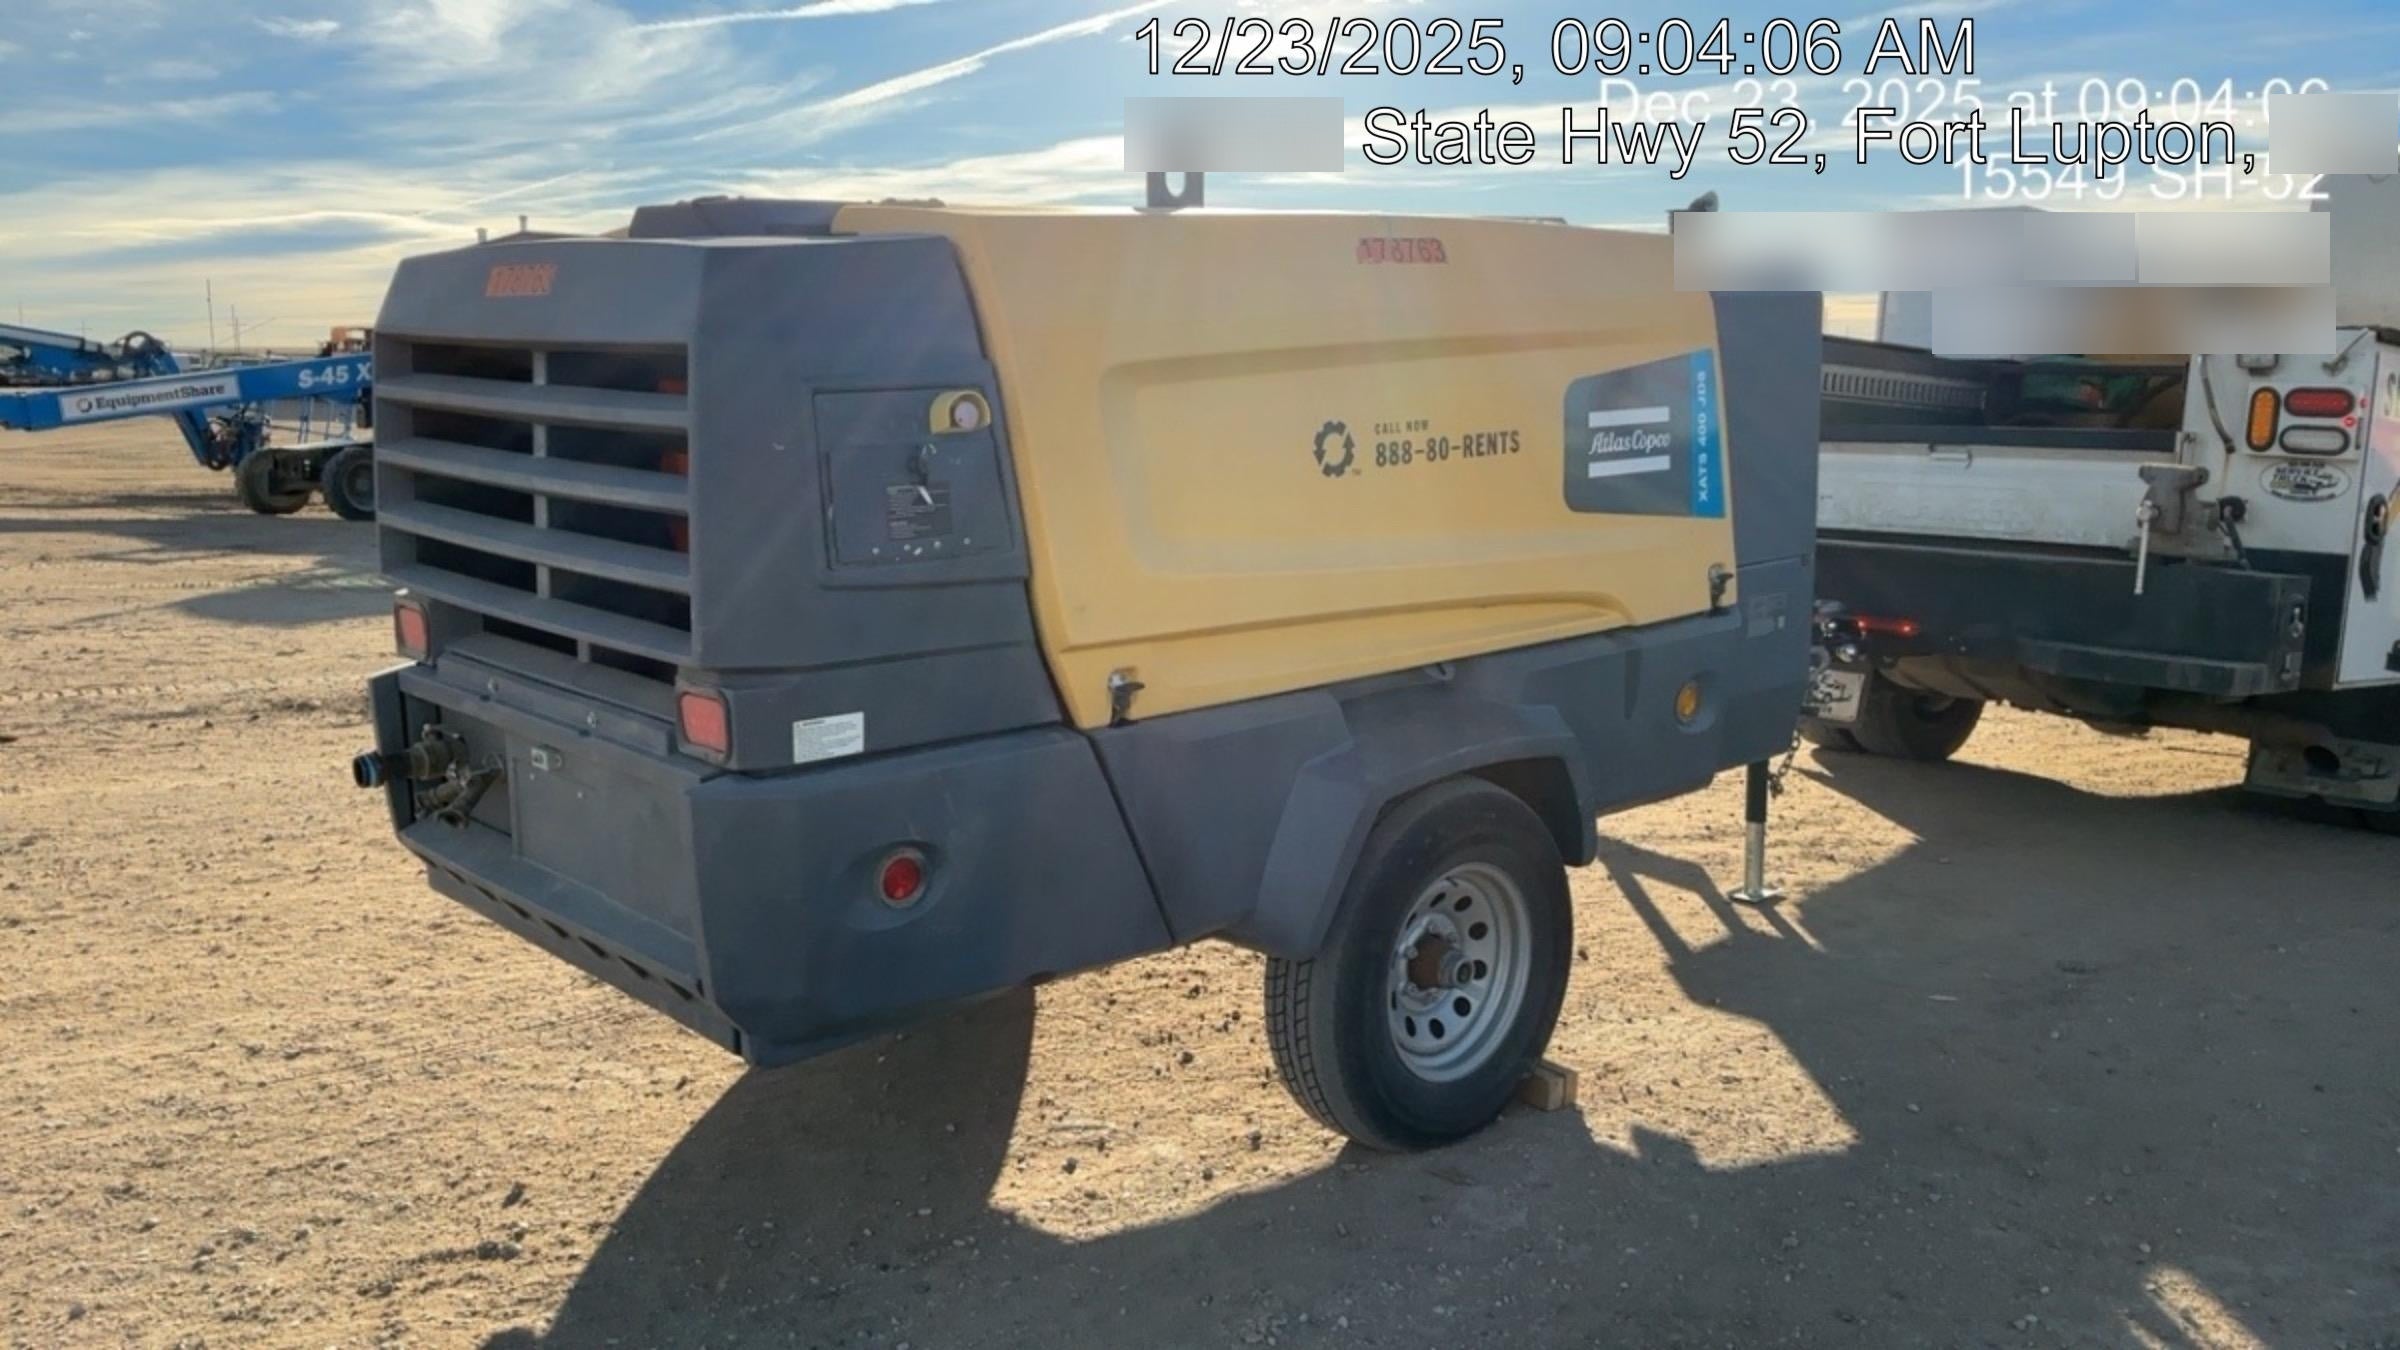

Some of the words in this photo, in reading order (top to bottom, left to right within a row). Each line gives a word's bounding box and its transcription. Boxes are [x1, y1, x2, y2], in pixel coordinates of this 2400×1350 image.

[297, 365, 350, 389] S-45
[95, 382, 226, 410] EquipmentShare
[1374, 420, 1401, 436] CALL
[1405, 419, 1430, 432] NOW
[1697, 413, 1708, 447] 400
[1375, 429, 1521, 468] 888-80-RENTS
[1698, 453, 1709, 503] XATS
